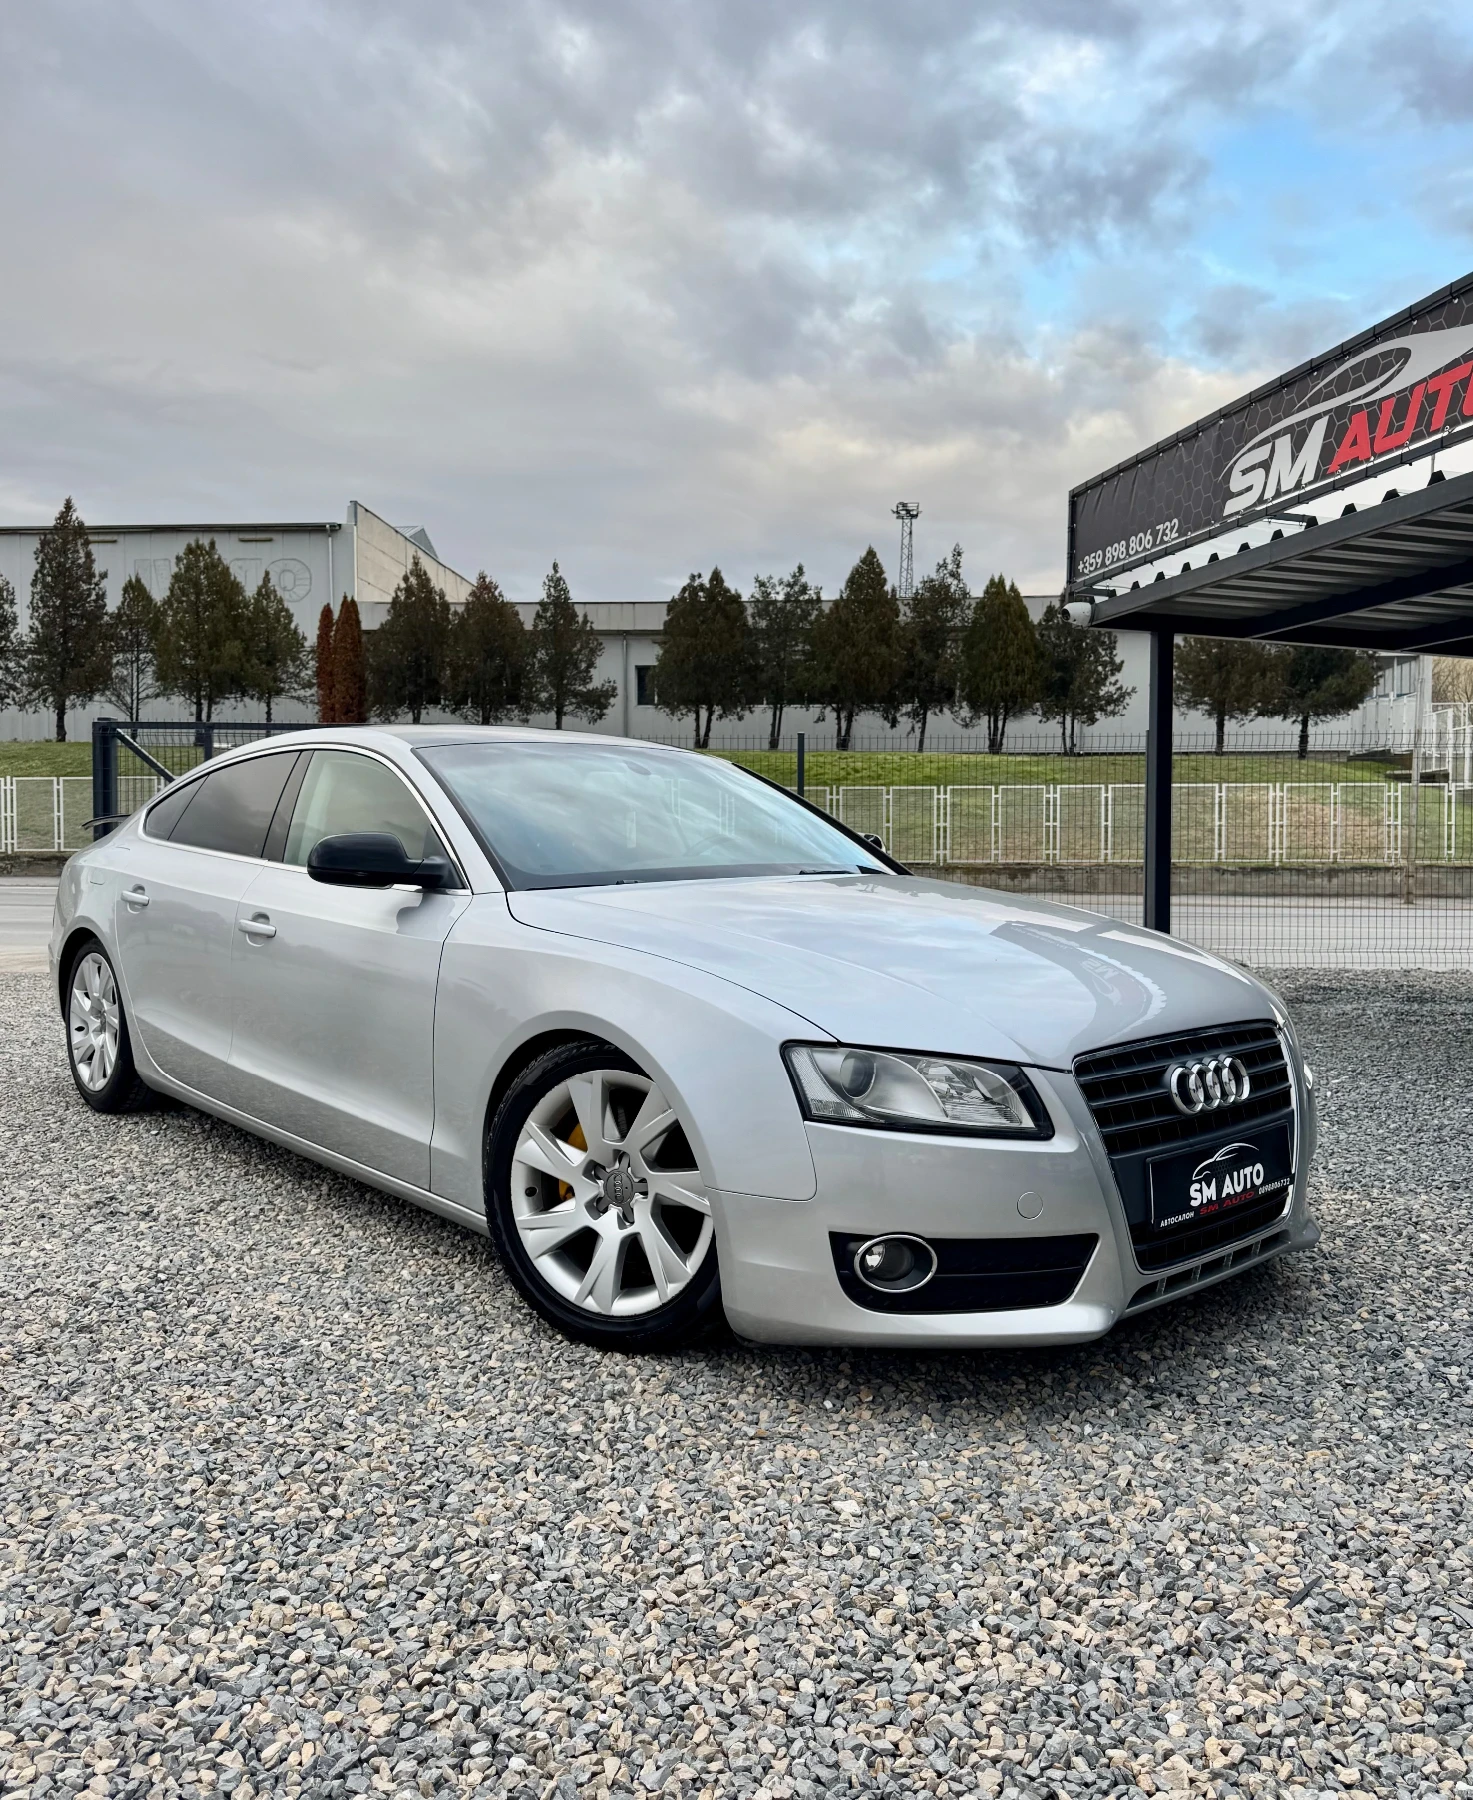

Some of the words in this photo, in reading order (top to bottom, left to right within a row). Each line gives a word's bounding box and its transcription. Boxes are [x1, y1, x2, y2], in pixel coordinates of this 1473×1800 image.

[1223, 416, 1328, 517] SM
[1326, 360, 1473, 474] AUT
[1078, 550, 1103, 574] +359
[1105, 540, 1126, 566] 898
[1129, 529, 1153, 555] 806
[1156, 518, 1179, 544] 732
[1160, 1211, 1195, 1228] АВТОСАЛОН
[1199, 1203, 1219, 1215] SM
[1223, 1191, 1255, 1207] AUTO
[1189, 1178, 1217, 1207] SM
[1221, 1162, 1264, 1198] AUTO
